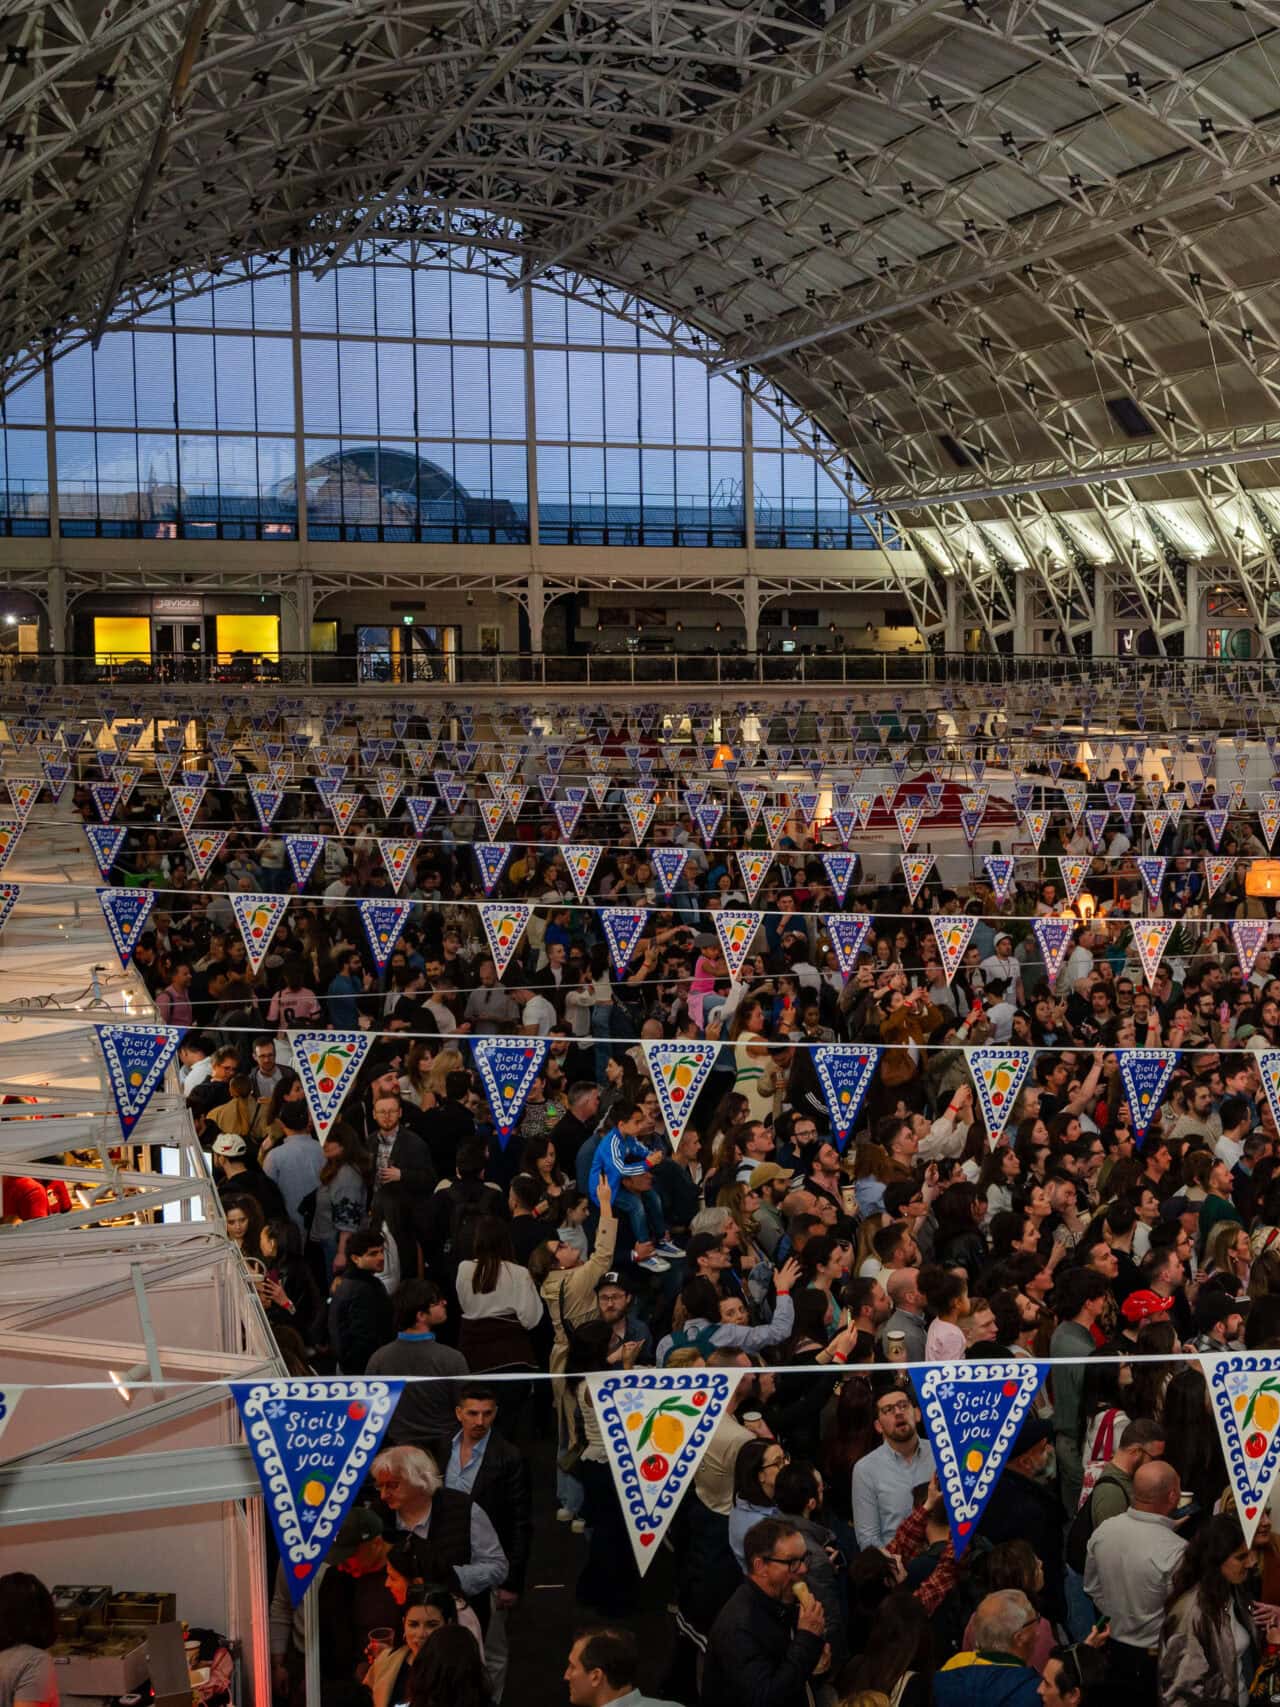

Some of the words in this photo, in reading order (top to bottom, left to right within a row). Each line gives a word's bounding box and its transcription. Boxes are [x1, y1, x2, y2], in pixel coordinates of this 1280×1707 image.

[122, 1037, 156, 1049] Sicily
[122, 1047, 154, 1057] loves
[127, 1058, 148, 1068] you
[495, 1053, 525, 1064] Sicily
[495, 1063, 524, 1072] loves
[832, 1060, 859, 1071] Sicily
[1135, 1063, 1160, 1073] Sicily
[500, 1073, 519, 1082] you
[833, 1069, 858, 1078] loves
[1135, 1072, 1158, 1081] loves
[837, 1079, 854, 1088] you
[1139, 1081, 1154, 1090] you
[953, 1389, 1002, 1410] Sicily
[285, 1410, 348, 1433] Sicily
[954, 1408, 999, 1425] loves
[960, 1426, 991, 1444] you
[287, 1432, 346, 1449] loves
[295, 1452, 335, 1472] you
